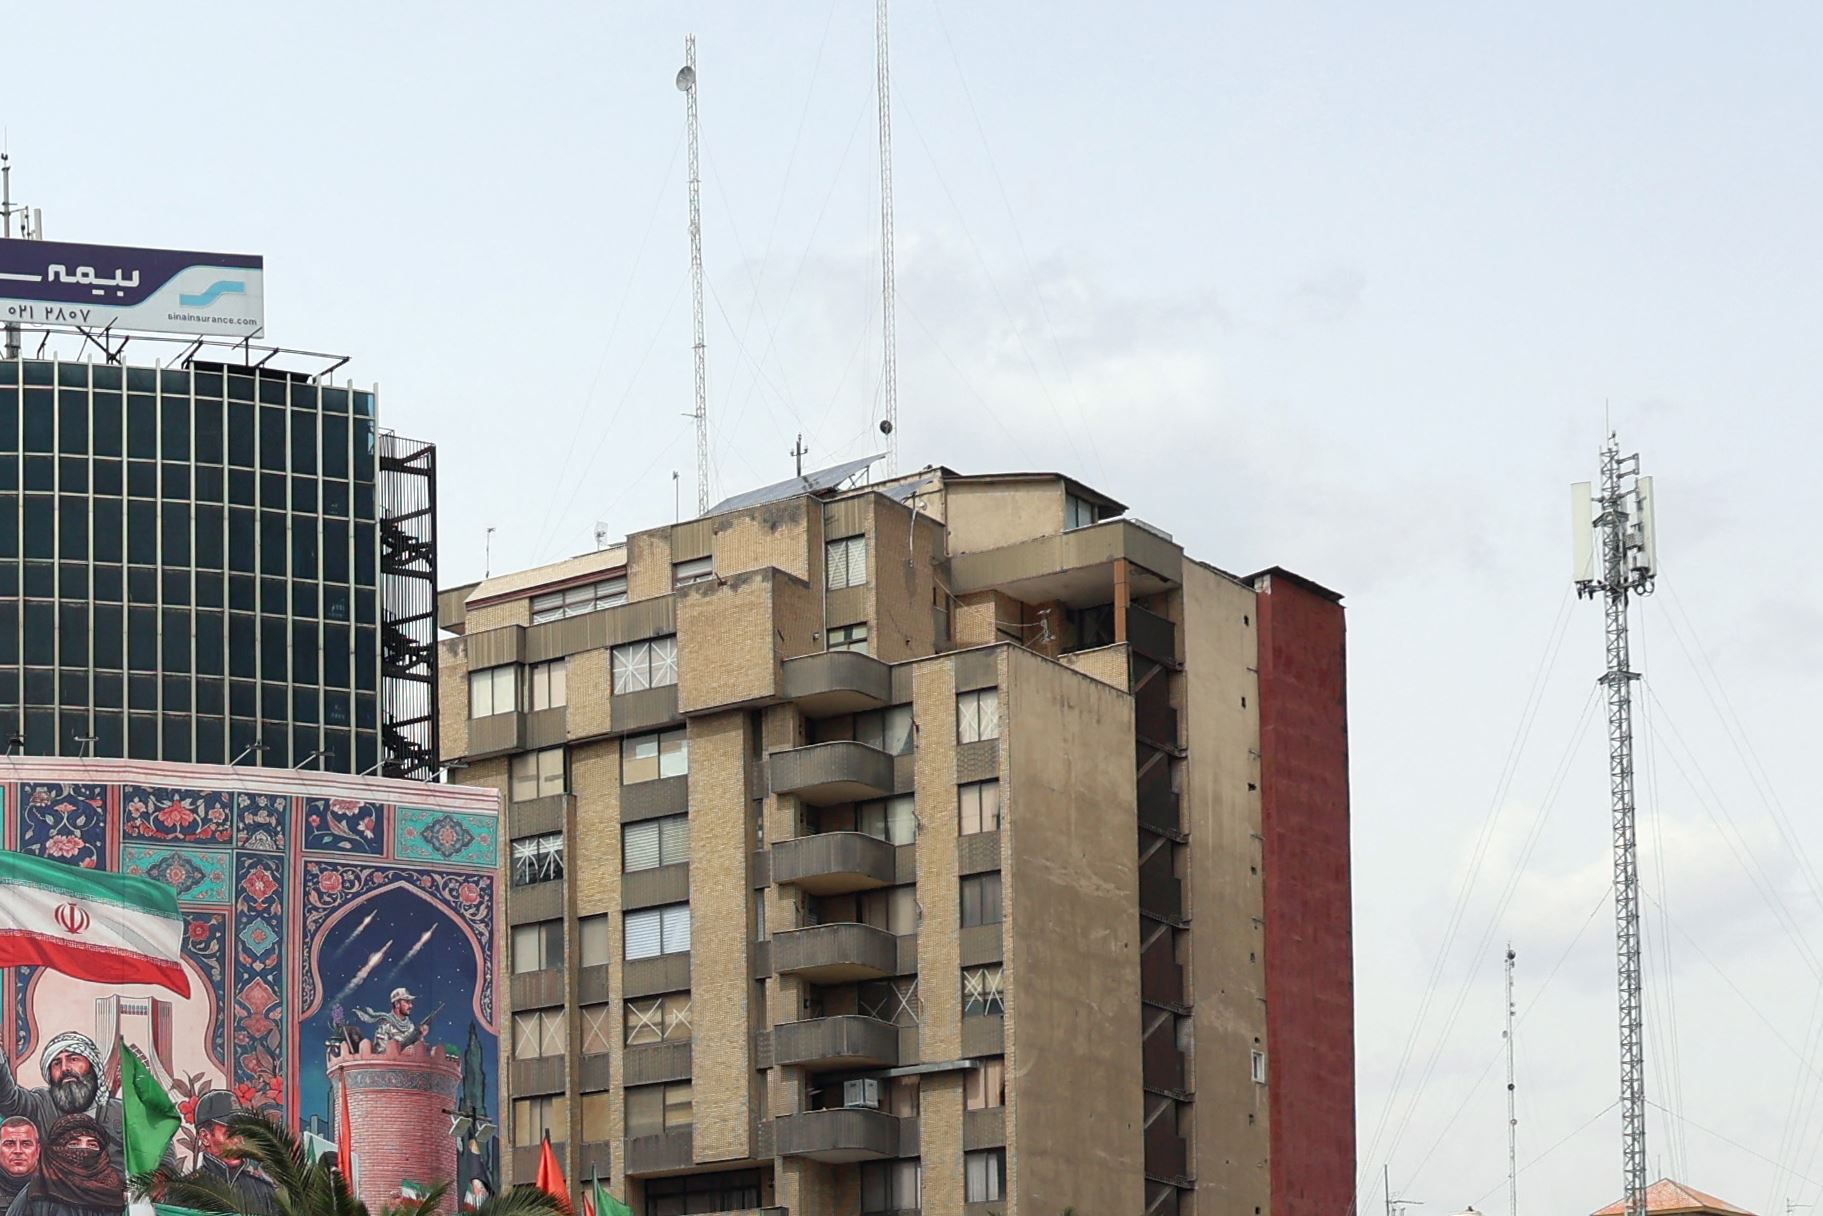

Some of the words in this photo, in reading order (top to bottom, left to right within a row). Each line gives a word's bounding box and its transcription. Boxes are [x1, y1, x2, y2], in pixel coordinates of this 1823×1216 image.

[48, 263, 140, 297] بیمه
[8, 305, 34, 320] ۰۲۱
[45, 306, 91, 322] ۲۸۰۷
[167, 311, 258, 327] sinainsurance.com
